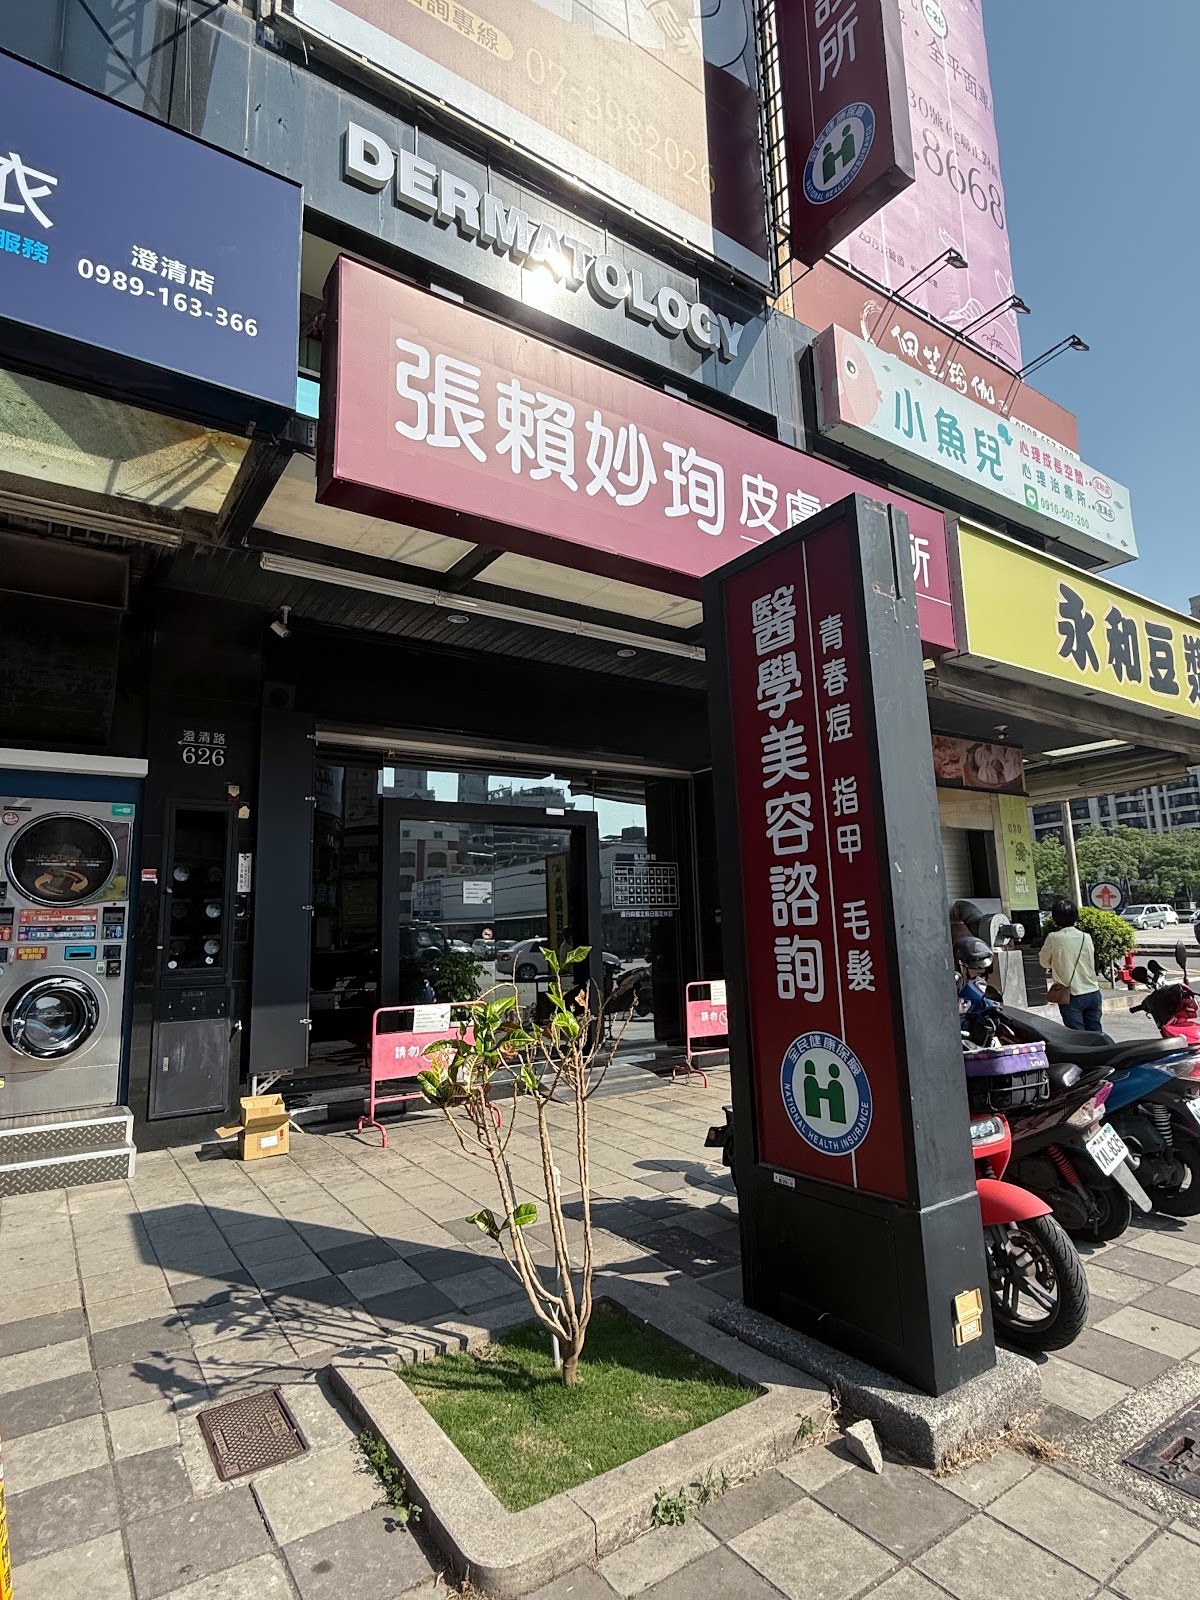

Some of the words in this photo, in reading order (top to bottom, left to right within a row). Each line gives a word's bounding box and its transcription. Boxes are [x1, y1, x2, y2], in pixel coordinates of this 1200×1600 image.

[525, 47, 716, 195] 07-3982026
[825, 176, 851, 199] HEALTH
[131, 245, 216, 295] 澄清店
[344, 120, 744, 362] DERMATOLOGY
[77, 258, 259, 337] 0989-163-366
[394, 337, 726, 537] 張賴妙珣
[894, 387, 1004, 483] 小魚兒
[1021, 462, 1087, 508] 心理治療所
[1040, 497, 1090, 530] 0910-507-200
[818, 613, 853, 744] 青春痘
[182, 729, 226, 745] 澄清路
[182, 746, 225, 767] 626
[751, 584, 825, 1003] 醫學美容諮詢
[831, 775, 862, 863] 指甲
[842, 899, 876, 992] 毛髮
[394, 1045, 420, 1060] 請勿
[787, 1034, 863, 1078] 全民健康保險
[783, 1082, 806, 1134] NATIONAL
[807, 1131, 840, 1150] HEALTH
[840, 1101, 869, 1150] INSURANCE
